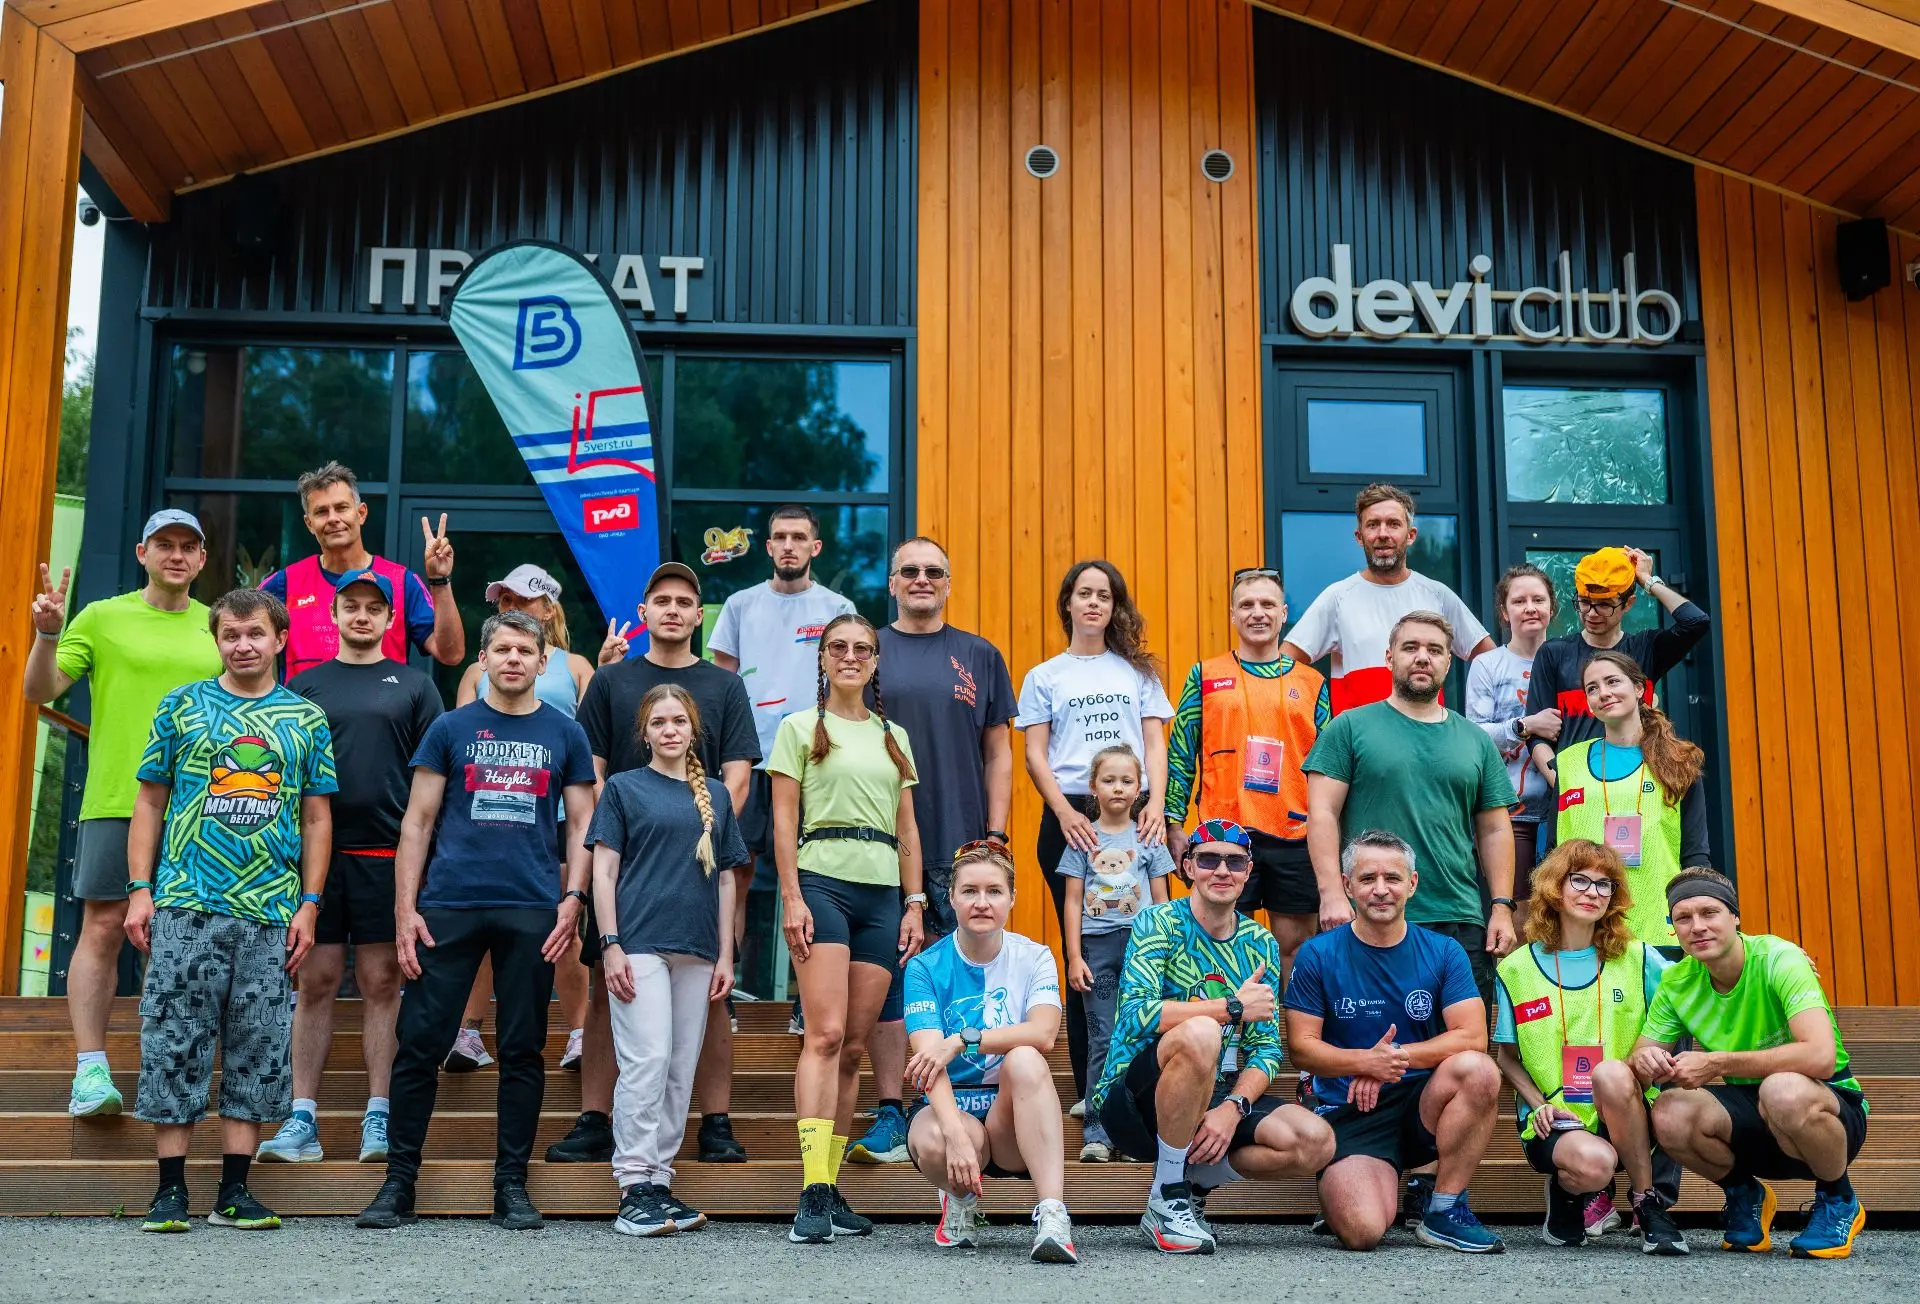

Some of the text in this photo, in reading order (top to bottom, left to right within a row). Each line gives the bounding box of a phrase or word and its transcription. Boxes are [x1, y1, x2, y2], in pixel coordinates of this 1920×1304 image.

[367, 246, 705, 318] ПРАТ
[1290, 243, 1682, 343] devi club
[583, 438, 633, 453] 5verst.ru
[1069, 693, 1131, 709] суббота
[1084, 712, 1119, 727] утро
[475, 728, 496, 740] The
[1085, 729, 1121, 742] парк
[466, 741, 551, 765] BROOKLYN
[485, 769, 533, 791] Heights
[230, 814, 260, 825] БЕГУТ
